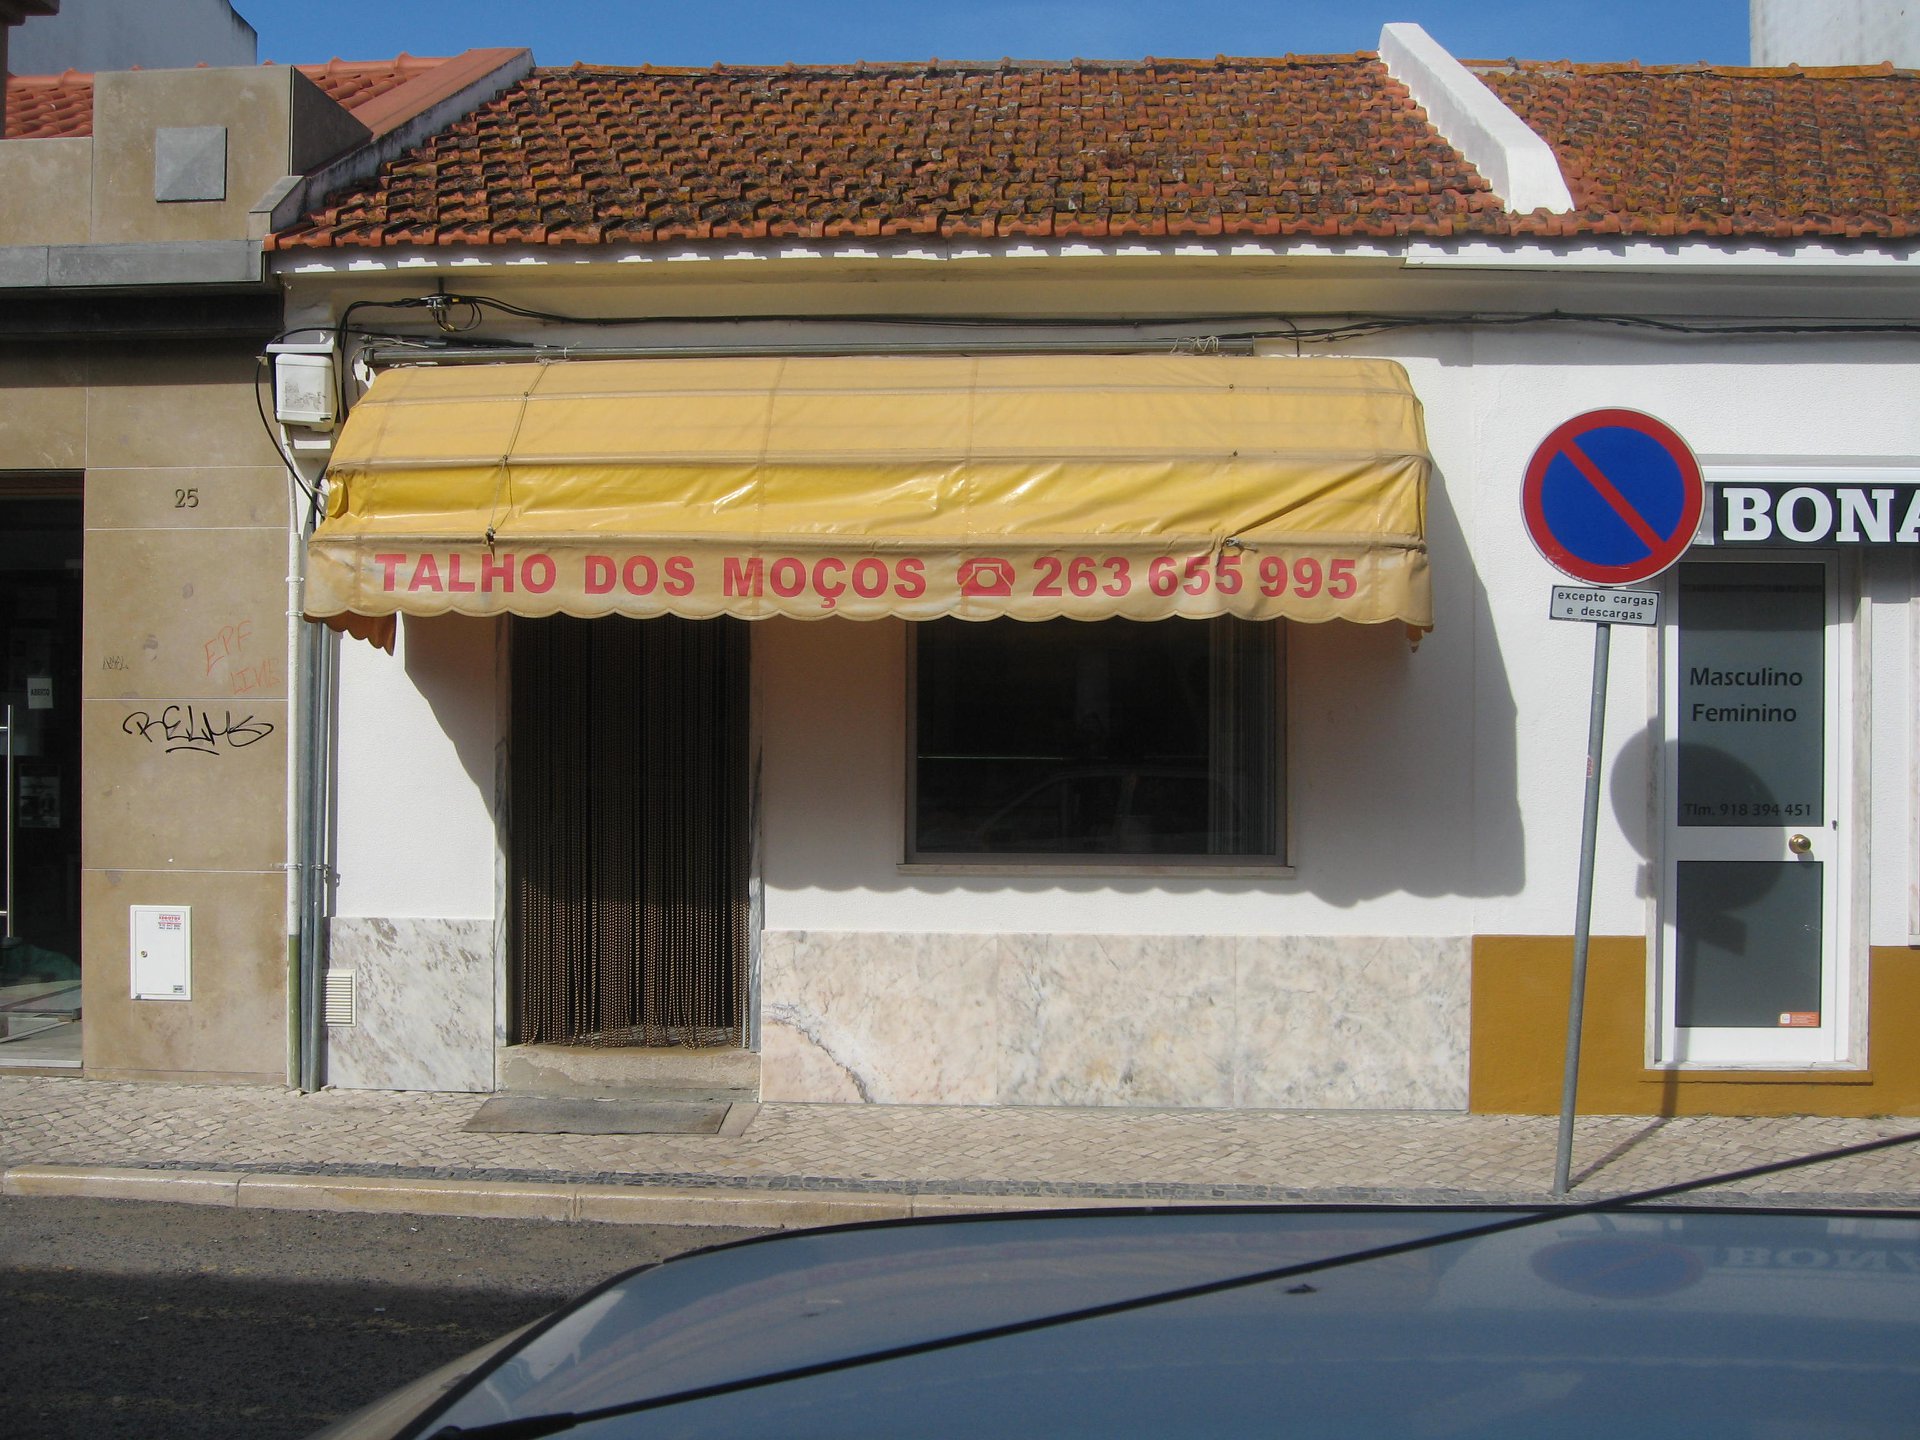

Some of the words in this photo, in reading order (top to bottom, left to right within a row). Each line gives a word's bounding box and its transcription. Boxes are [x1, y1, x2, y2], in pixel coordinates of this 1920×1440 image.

[175, 488, 199, 508] 25
[375, 553, 556, 593] TALHO
[584, 555, 696, 596] DOS
[723, 557, 927, 608] MOÇOS
[1032, 556, 1132, 597] 263
[1148, 556, 1243, 597] 655
[1259, 556, 1358, 599] 995
[1558, 591, 1606, 603] excepto
[1613, 595, 1654, 607] cargas
[1566, 607, 1574, 615] e
[1581, 606, 1643, 620] descargas
[1690, 667, 1803, 686] Masculino
[1692, 703, 1797, 722] Feminino
[1720, 803, 1748, 817] 918
[1752, 804, 1779, 817] 394
[1785, 804, 1811, 817] 451
